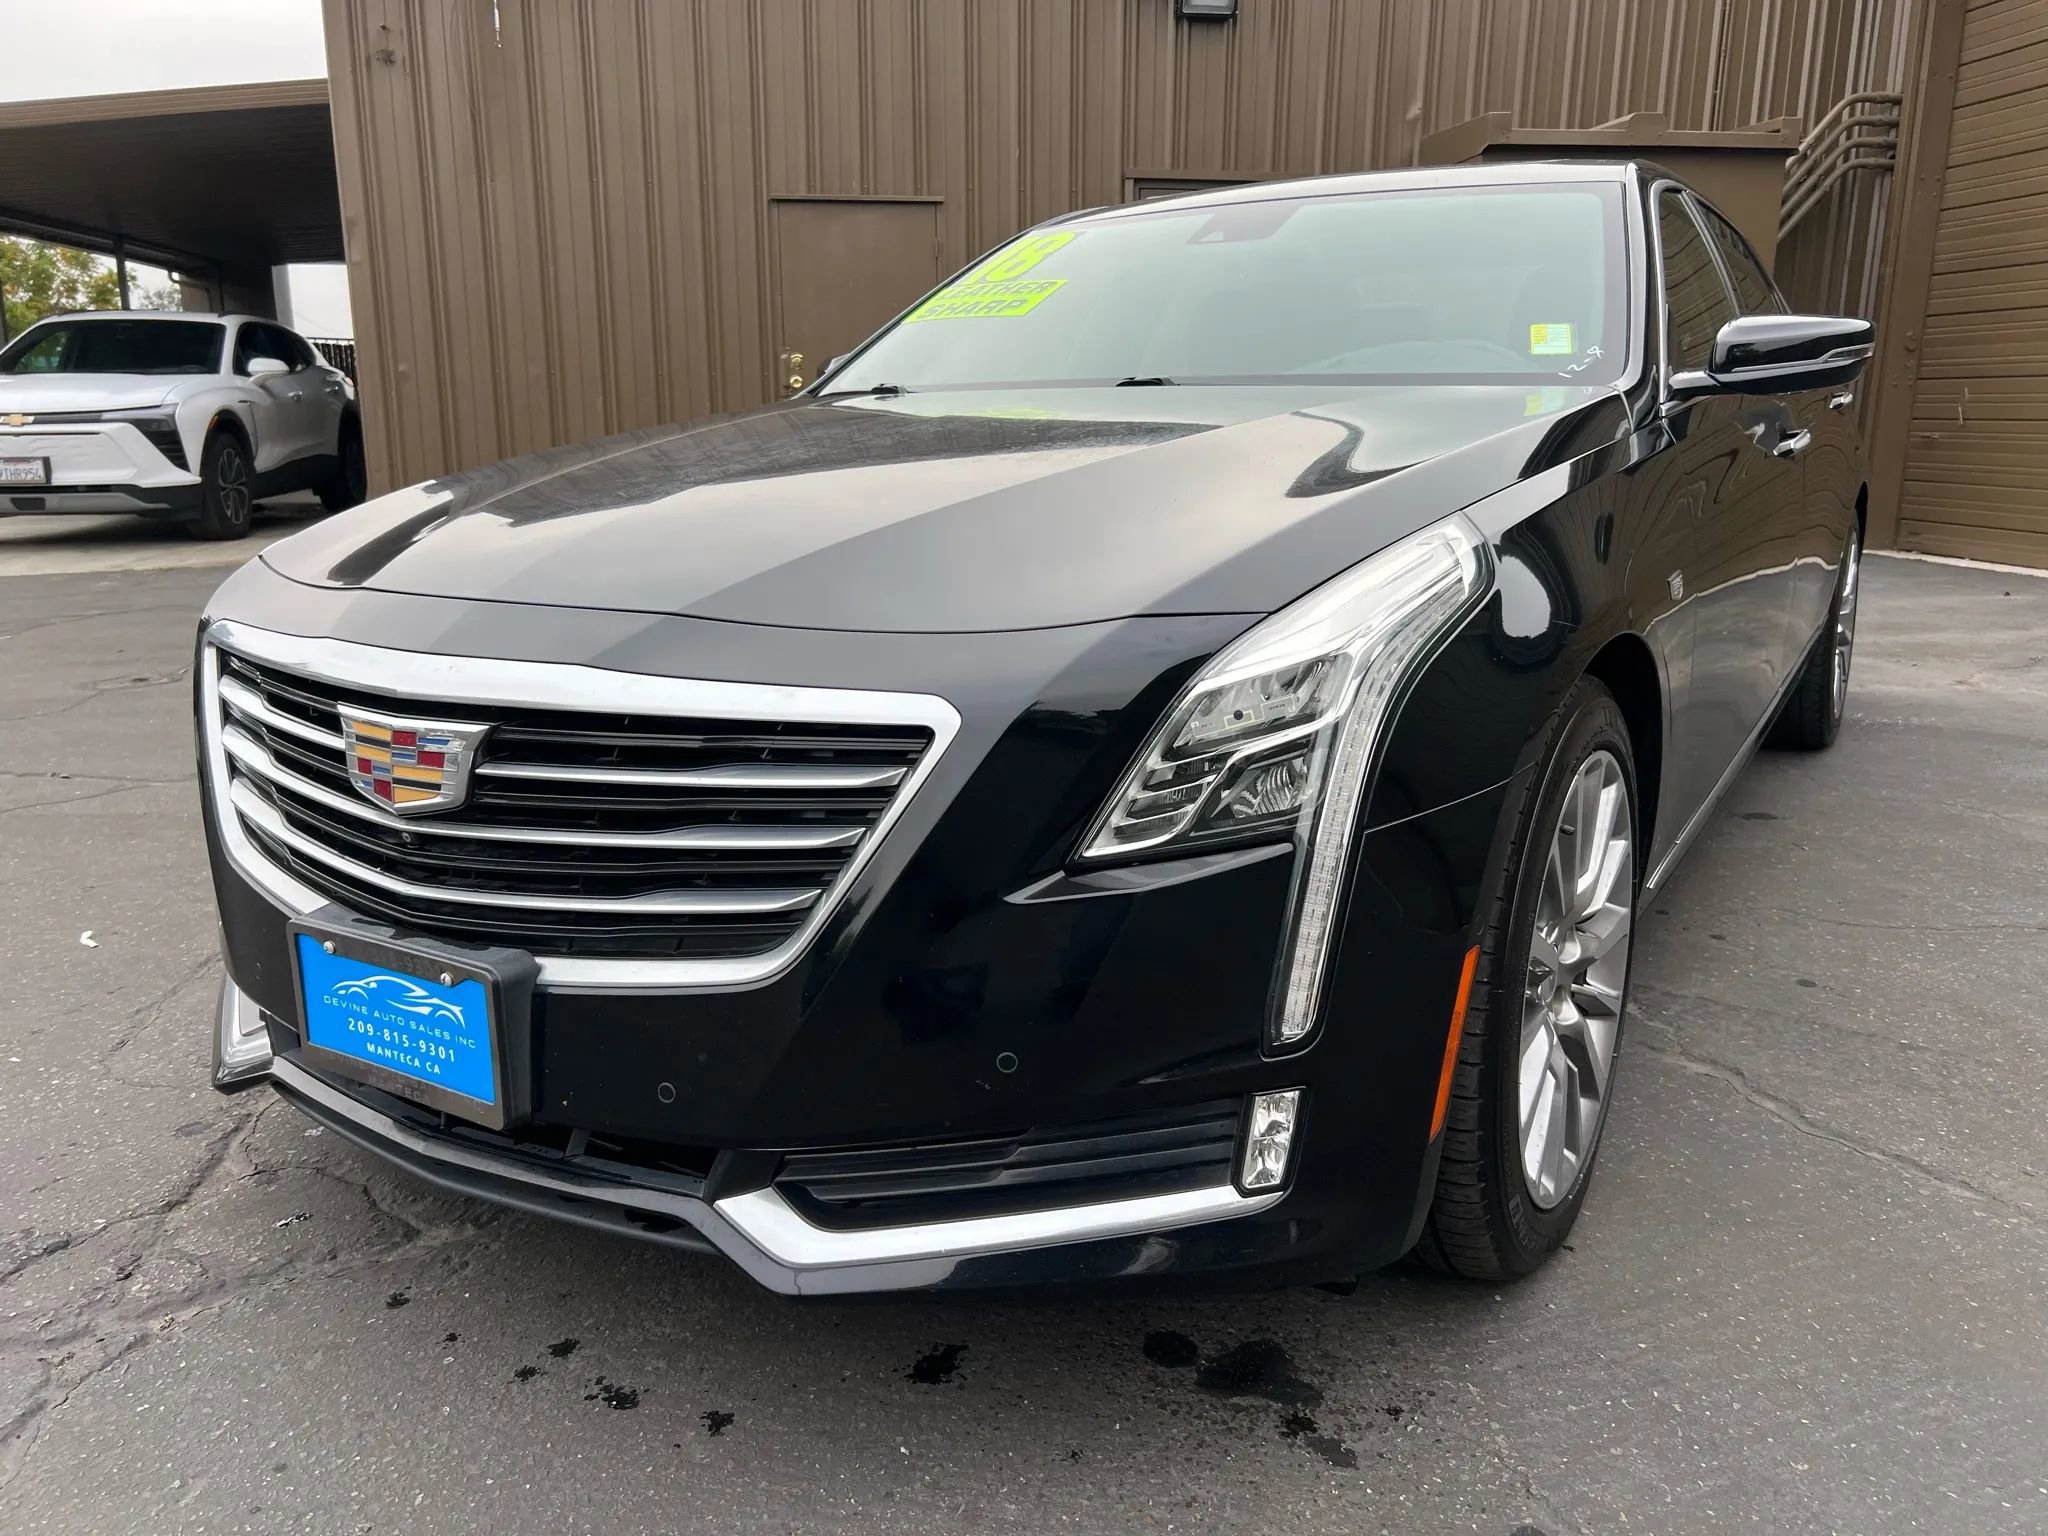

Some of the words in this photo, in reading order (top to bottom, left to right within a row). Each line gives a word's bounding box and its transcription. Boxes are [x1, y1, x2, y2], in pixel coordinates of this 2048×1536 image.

[936, 280, 1059, 300] LEATHER
[916, 299, 1029, 319] SHARP
[323, 995, 368, 1015] DEVINE
[374, 1010, 405, 1026] AUTO
[409, 1020, 451, 1040] SALES
[455, 1035, 476, 1048] INC
[348, 1017, 455, 1063] 209-815-9301
[367, 1042, 421, 1068] MANTECA
[425, 1061, 441, 1075] CA
